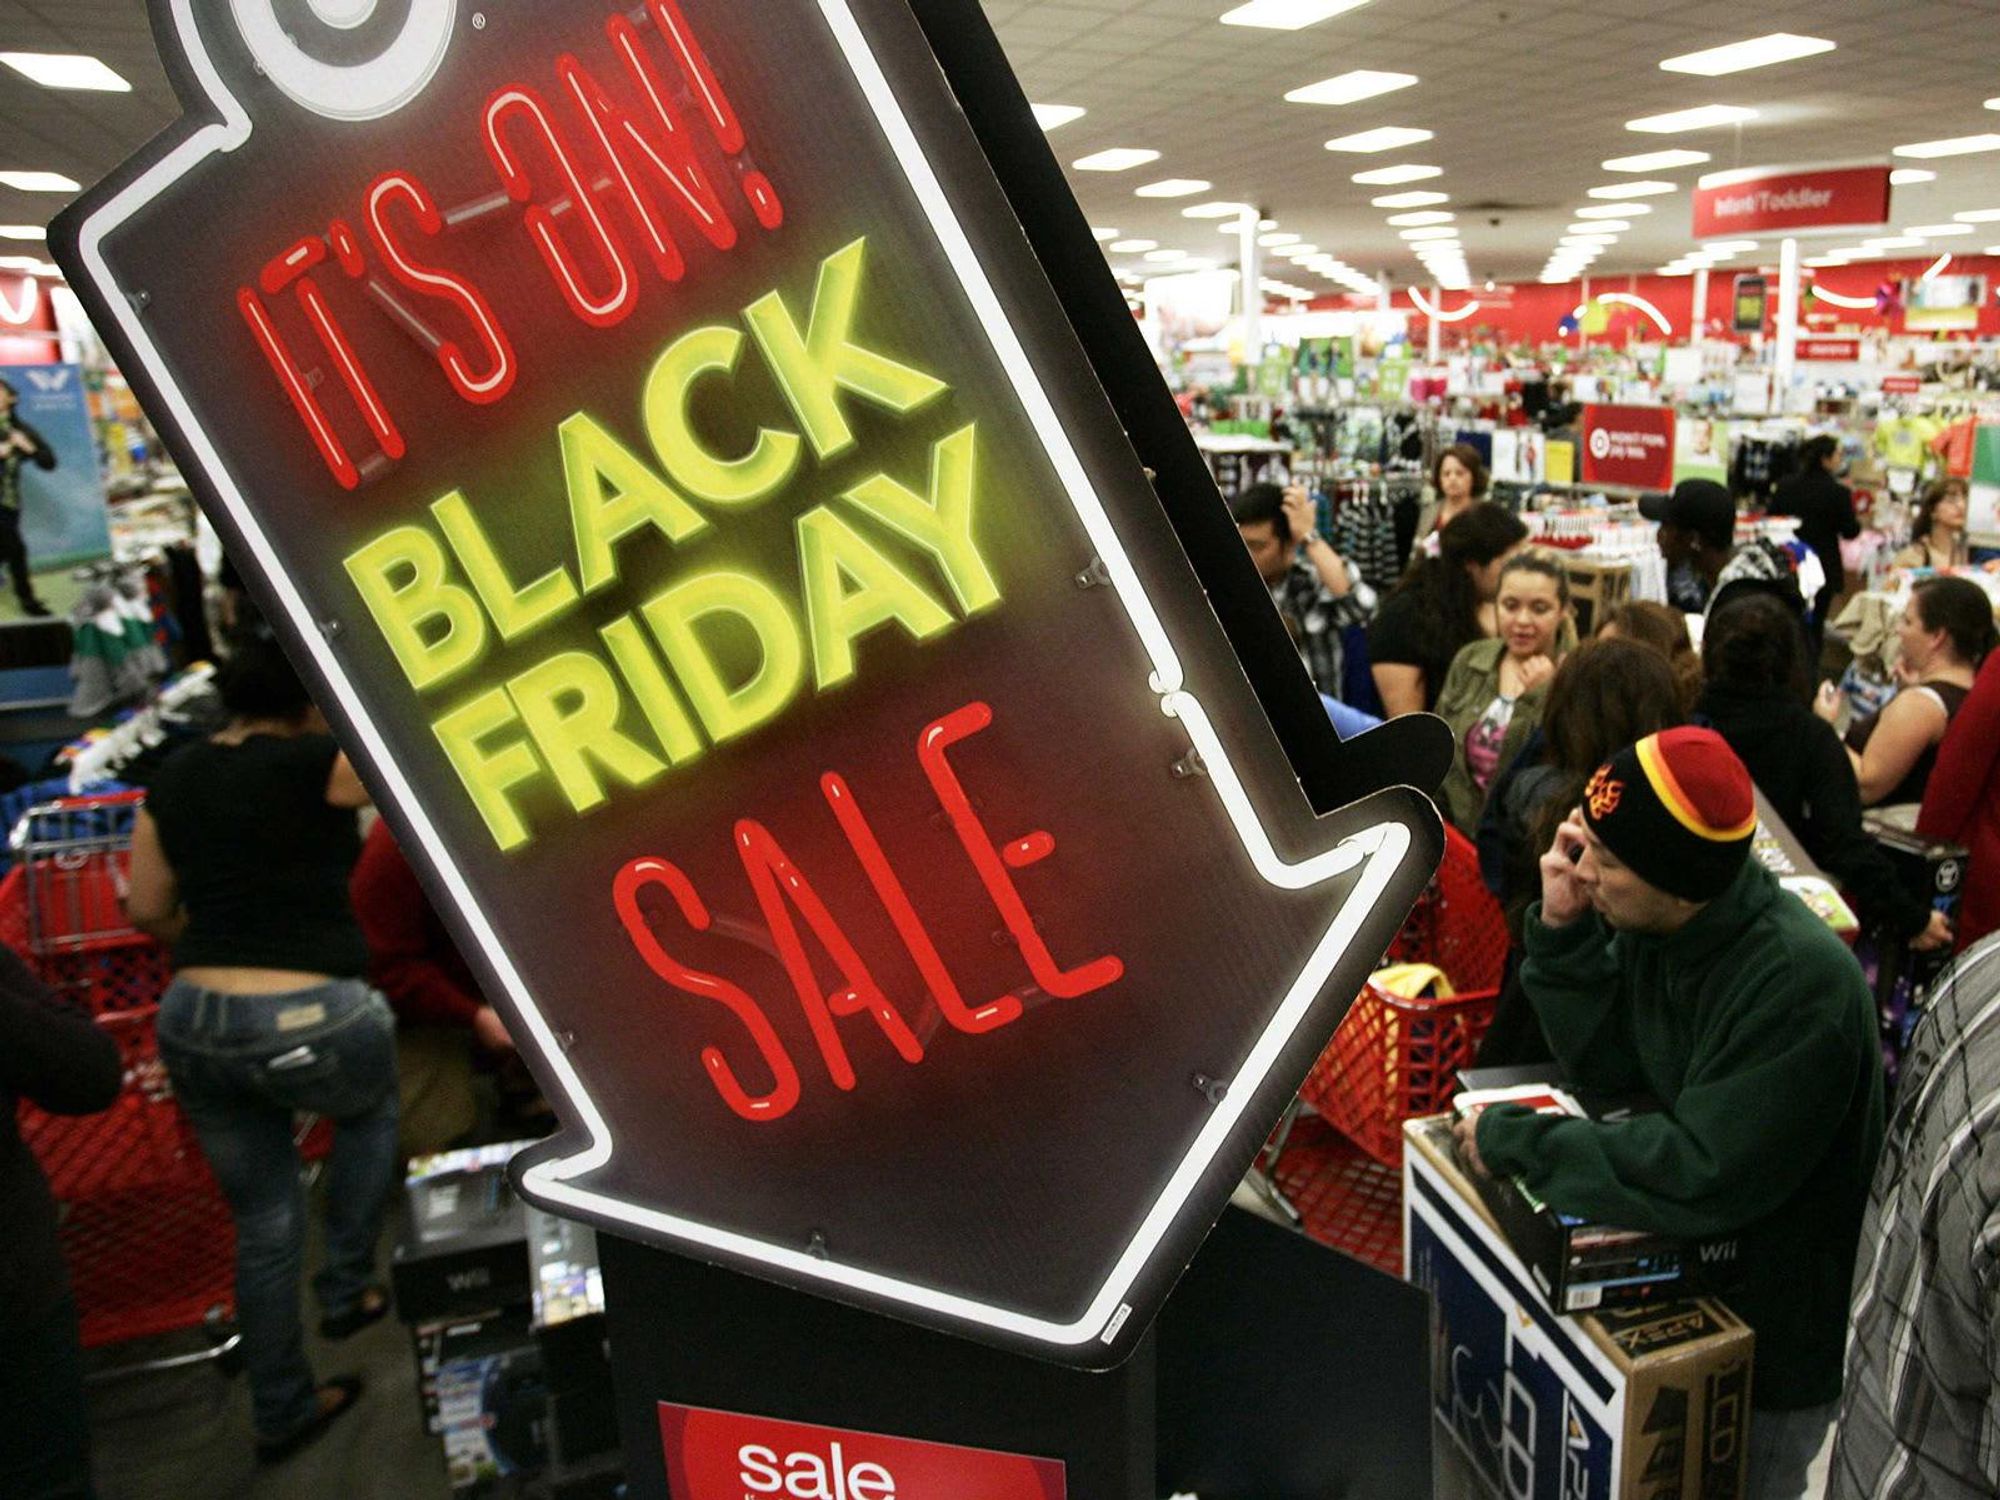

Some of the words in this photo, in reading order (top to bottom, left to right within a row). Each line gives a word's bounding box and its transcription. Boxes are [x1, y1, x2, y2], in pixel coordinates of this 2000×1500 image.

[238, 170, 516, 490] IT'S
[343, 236, 947, 690] BLACK
[431, 424, 1001, 851] FRIDAY
[613, 702, 1124, 1120] SALE
[1701, 1240, 1738, 1263] Wii
[738, 1442, 896, 1500] sale
